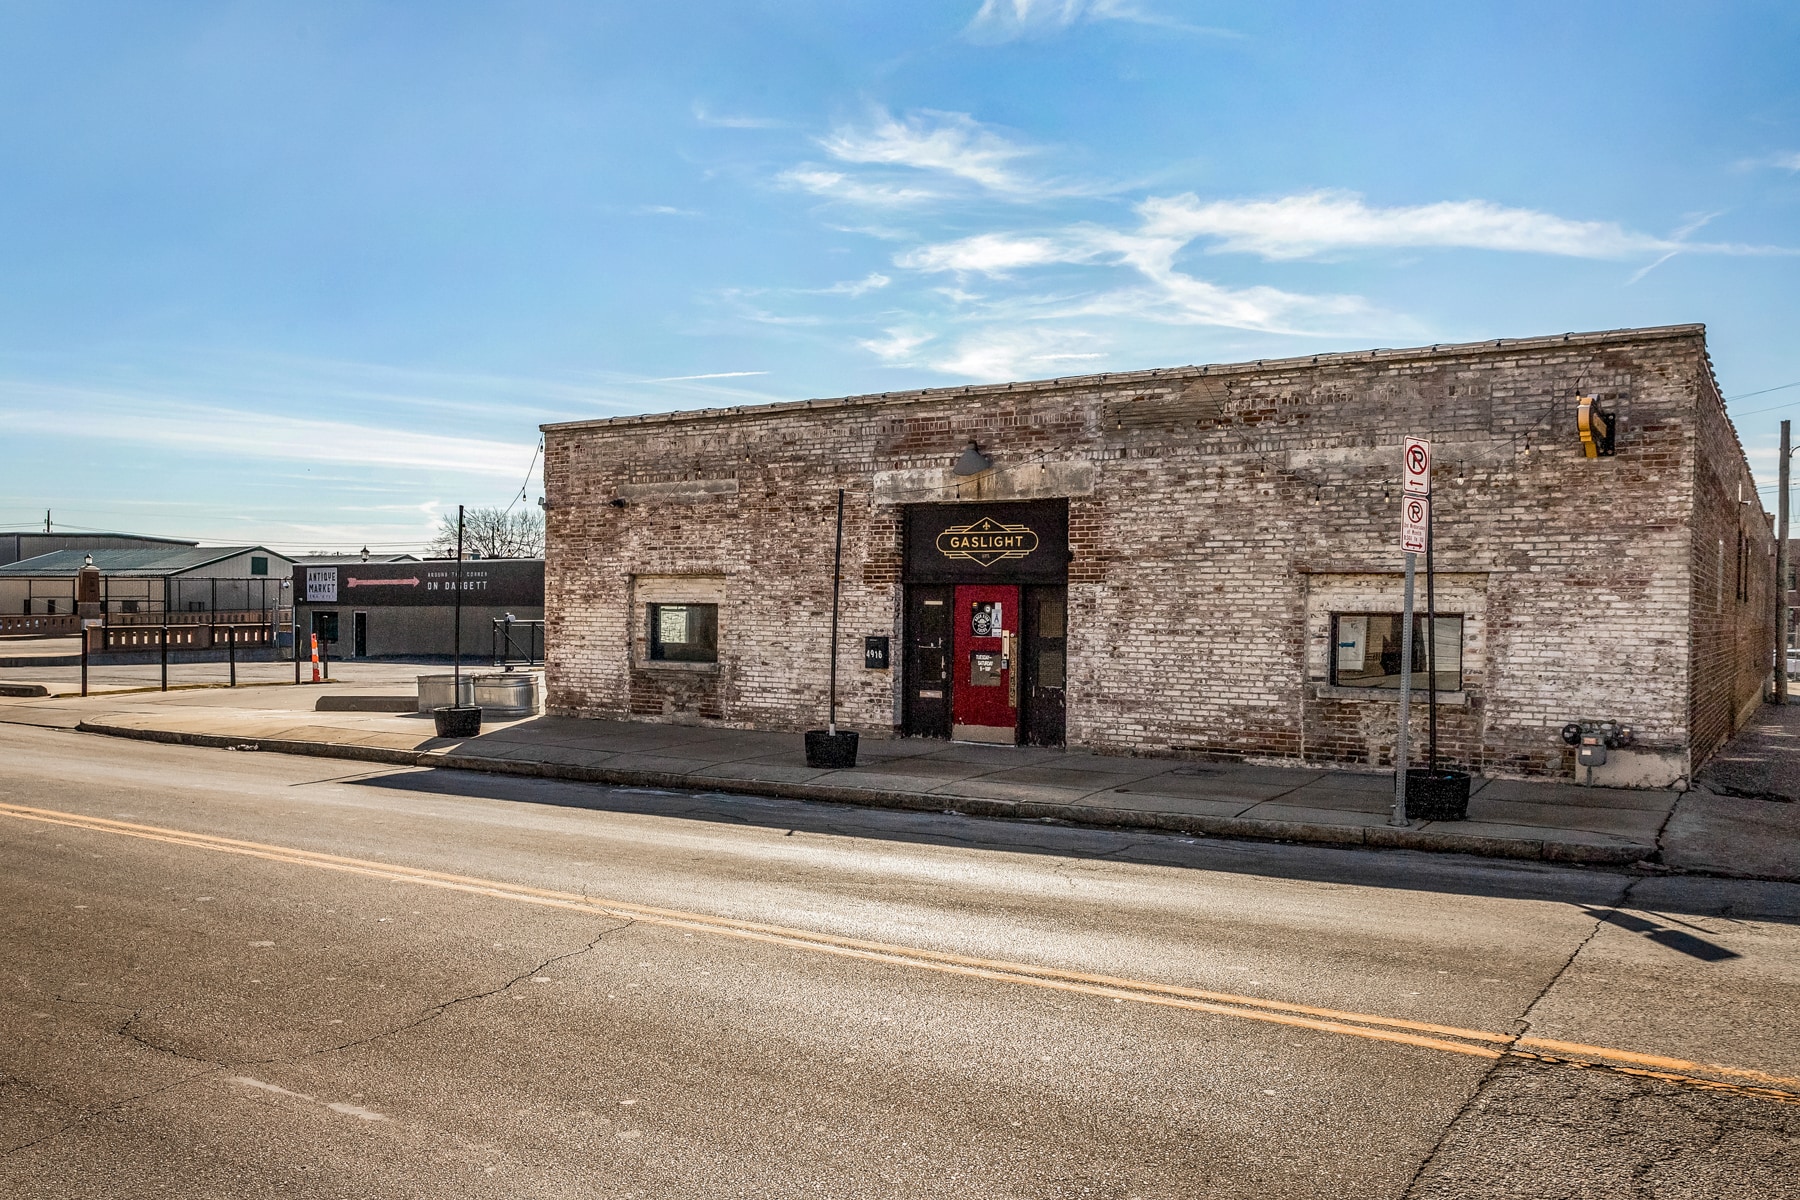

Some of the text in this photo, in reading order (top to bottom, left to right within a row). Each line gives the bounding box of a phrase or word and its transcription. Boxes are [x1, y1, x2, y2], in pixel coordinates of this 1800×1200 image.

[950, 535, 1023, 548] GASLIGHT
[308, 571, 336, 582] ANTIQUE
[308, 583, 336, 593] MARKET
[427, 581, 439, 590] ON
